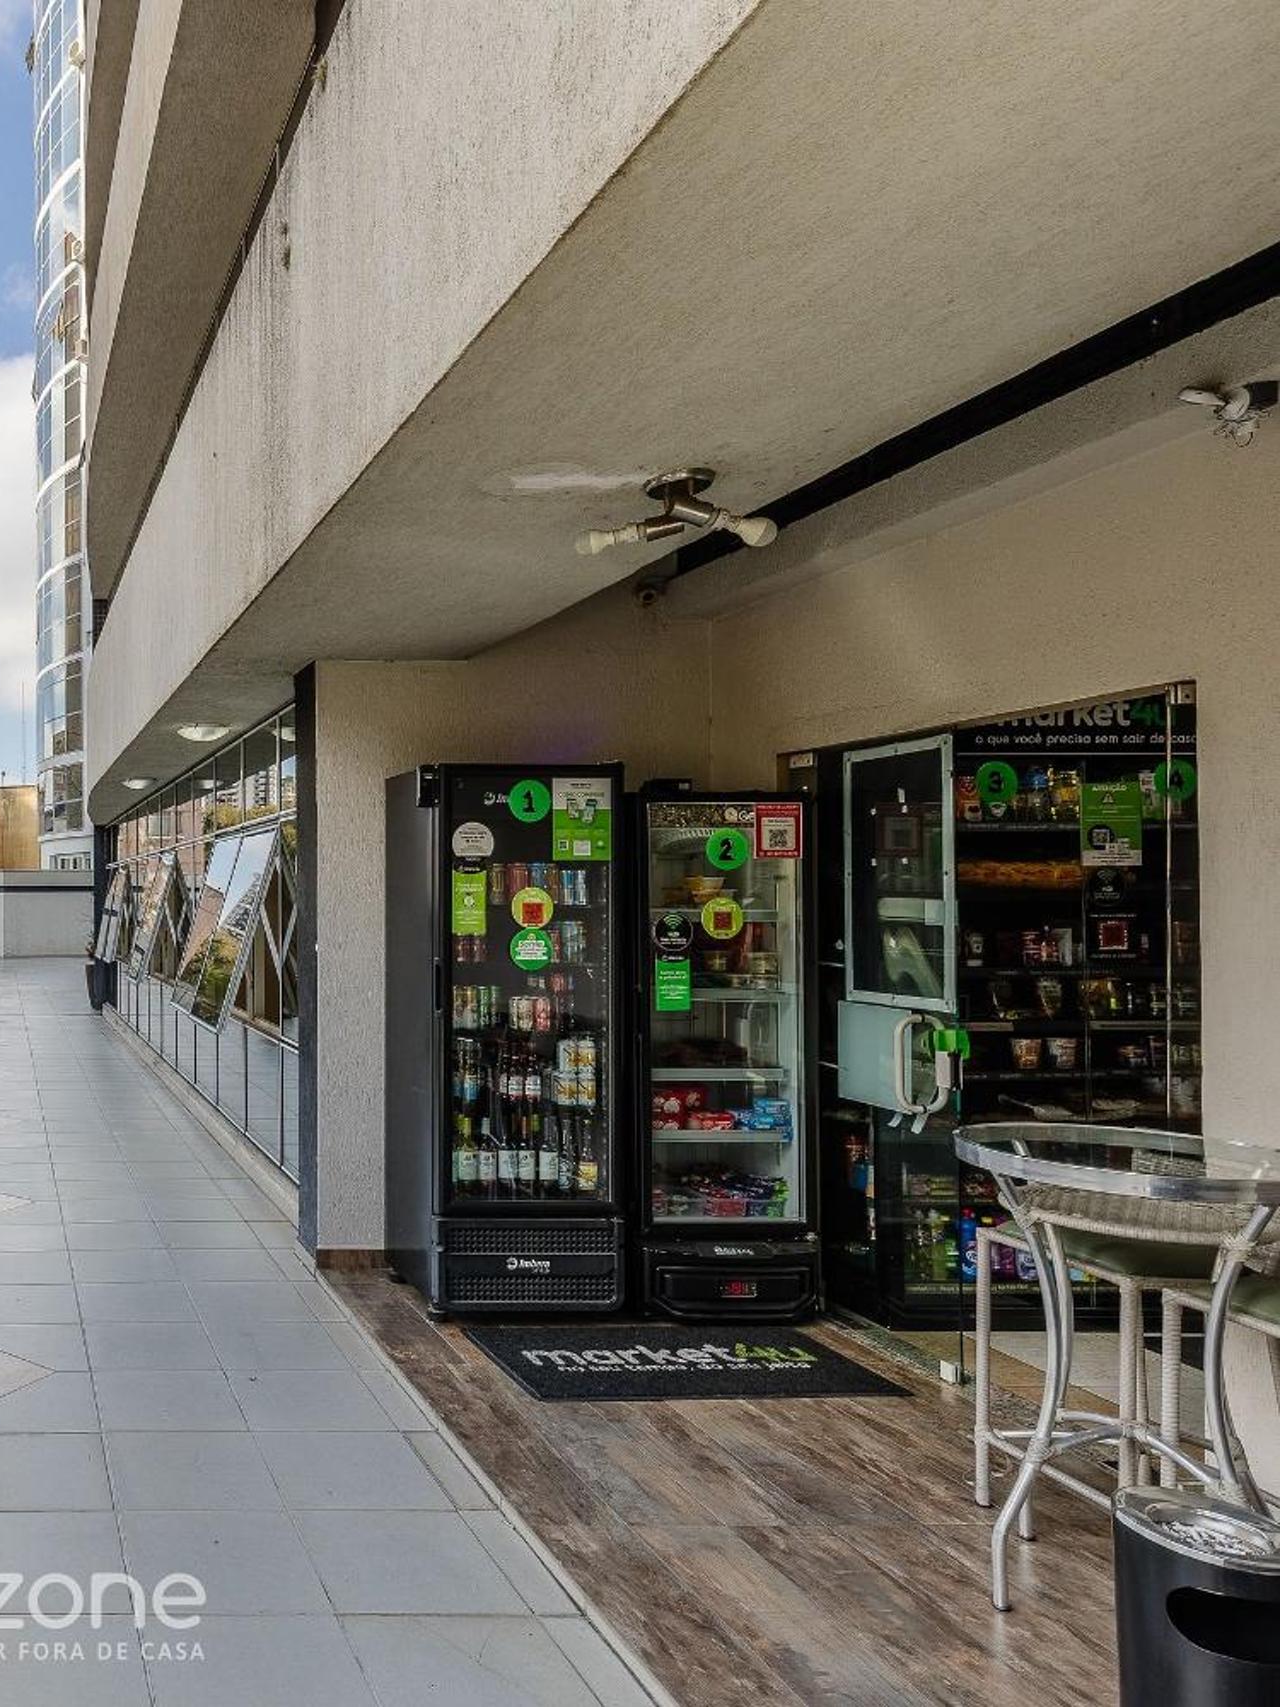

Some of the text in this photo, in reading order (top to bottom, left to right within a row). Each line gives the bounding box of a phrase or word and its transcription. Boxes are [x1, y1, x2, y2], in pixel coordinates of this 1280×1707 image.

[975, 736, 984, 745] o
[987, 736, 1010, 748] que
[1013, 732, 1042, 745] você
[1046, 733, 1091, 748] precisa
[1095, 736, 1119, 744] sem
[1122, 733, 1146, 744] sair
[1150, 733, 1165, 744] de
[988, 771, 1005, 793] 3
[522, 790, 537, 813] 1
[719, 837, 735, 861] 2
[521, 1342, 819, 1366] market4u
